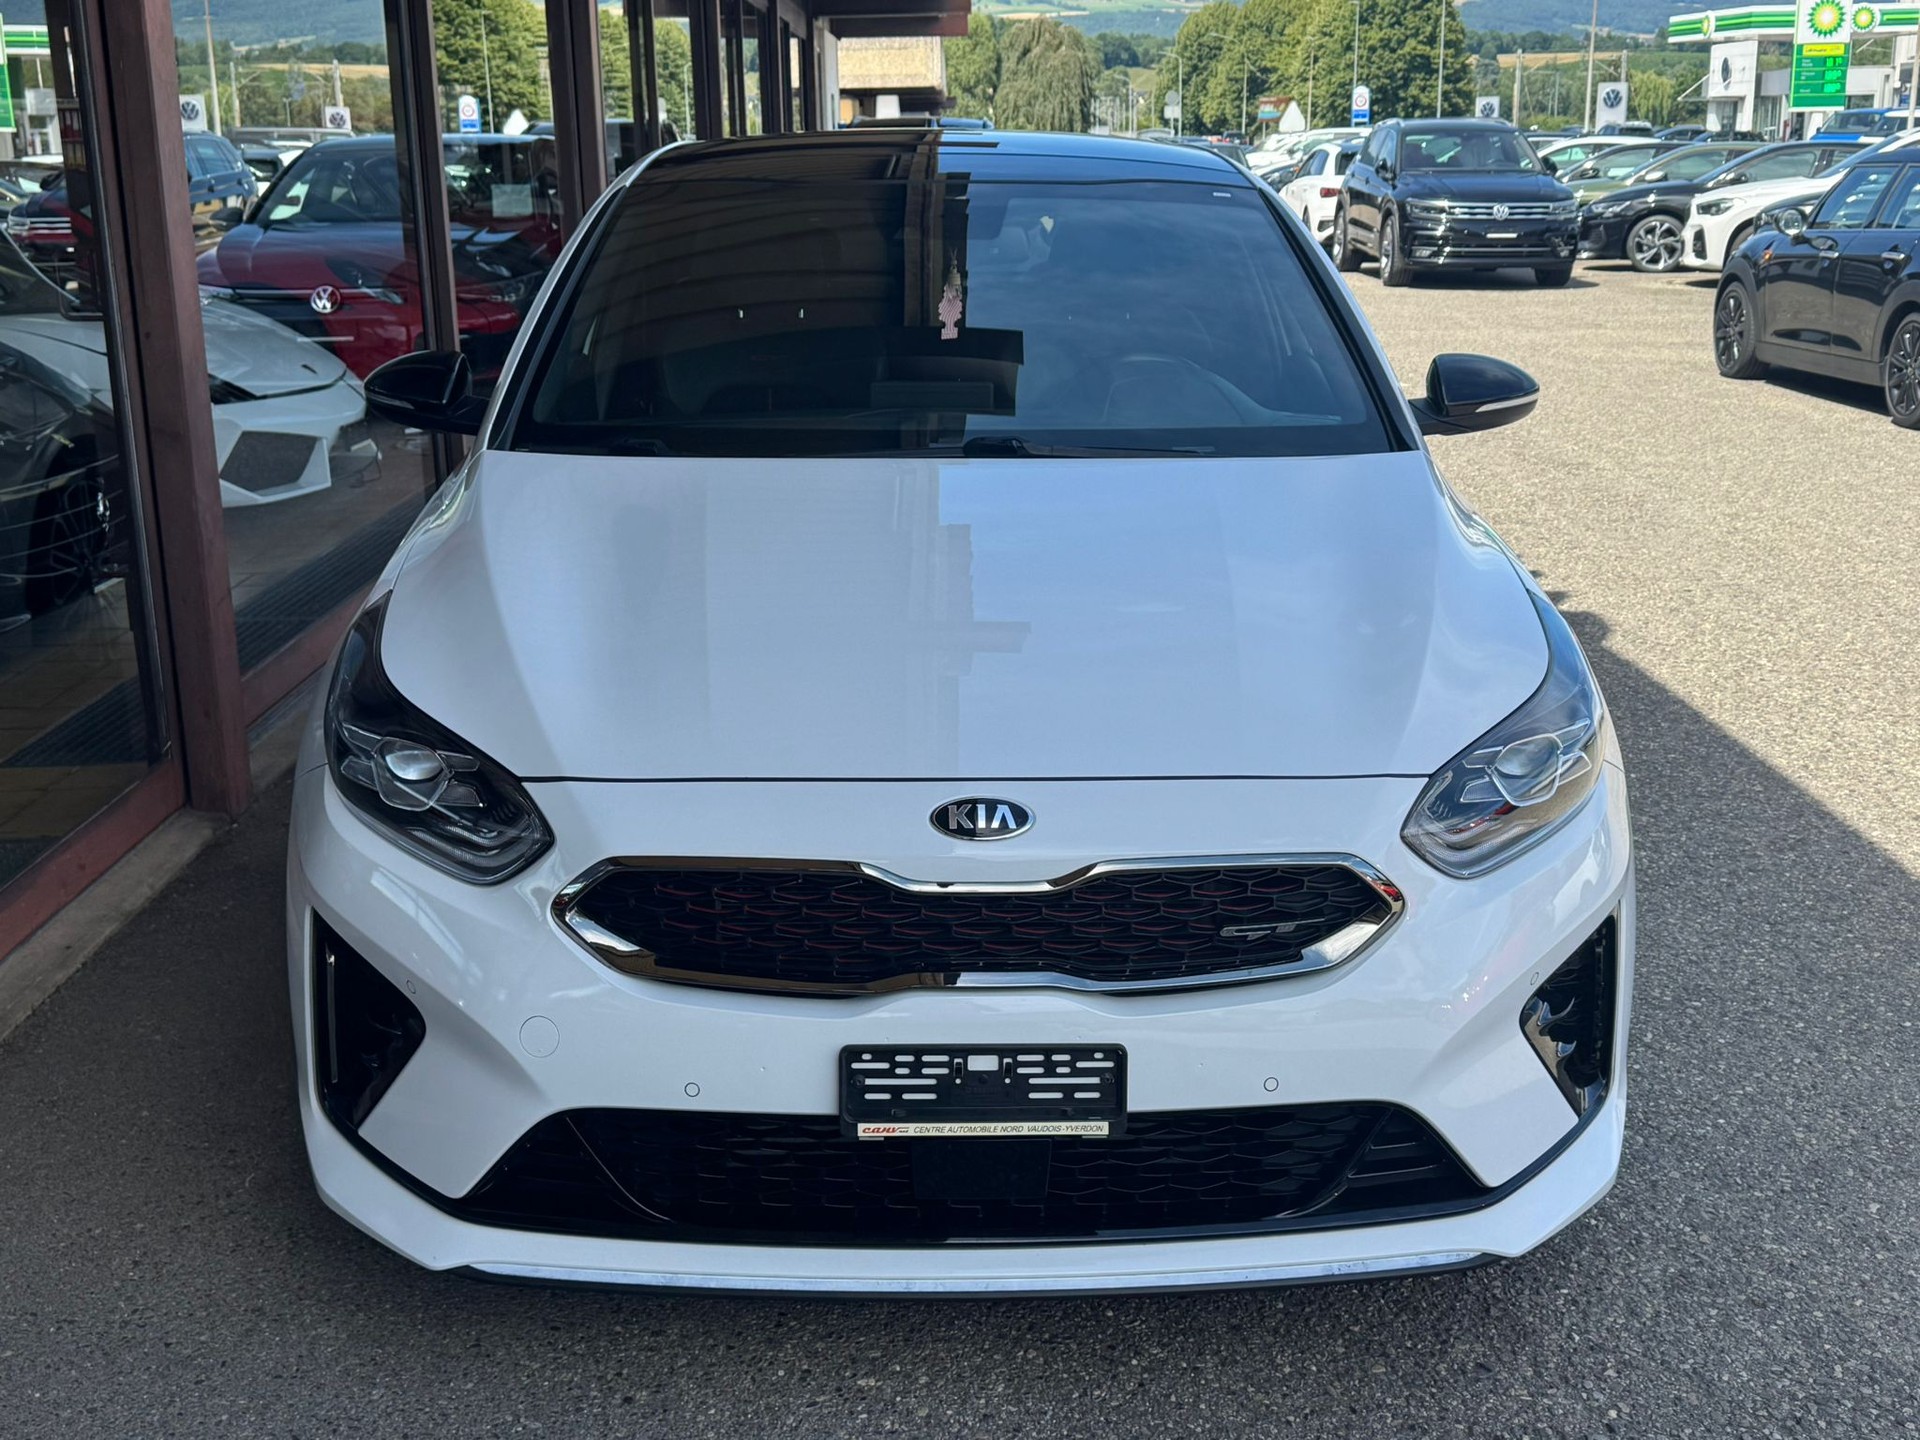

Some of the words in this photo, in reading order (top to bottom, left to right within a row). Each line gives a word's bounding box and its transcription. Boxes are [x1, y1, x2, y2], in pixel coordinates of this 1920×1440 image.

[947, 803, 1017, 830] KIA
[913, 1125, 947, 1134] CENTRE
[947, 1125, 999, 1134] AUTOMOBILE
[1000, 1125, 1025, 1134] NORD
